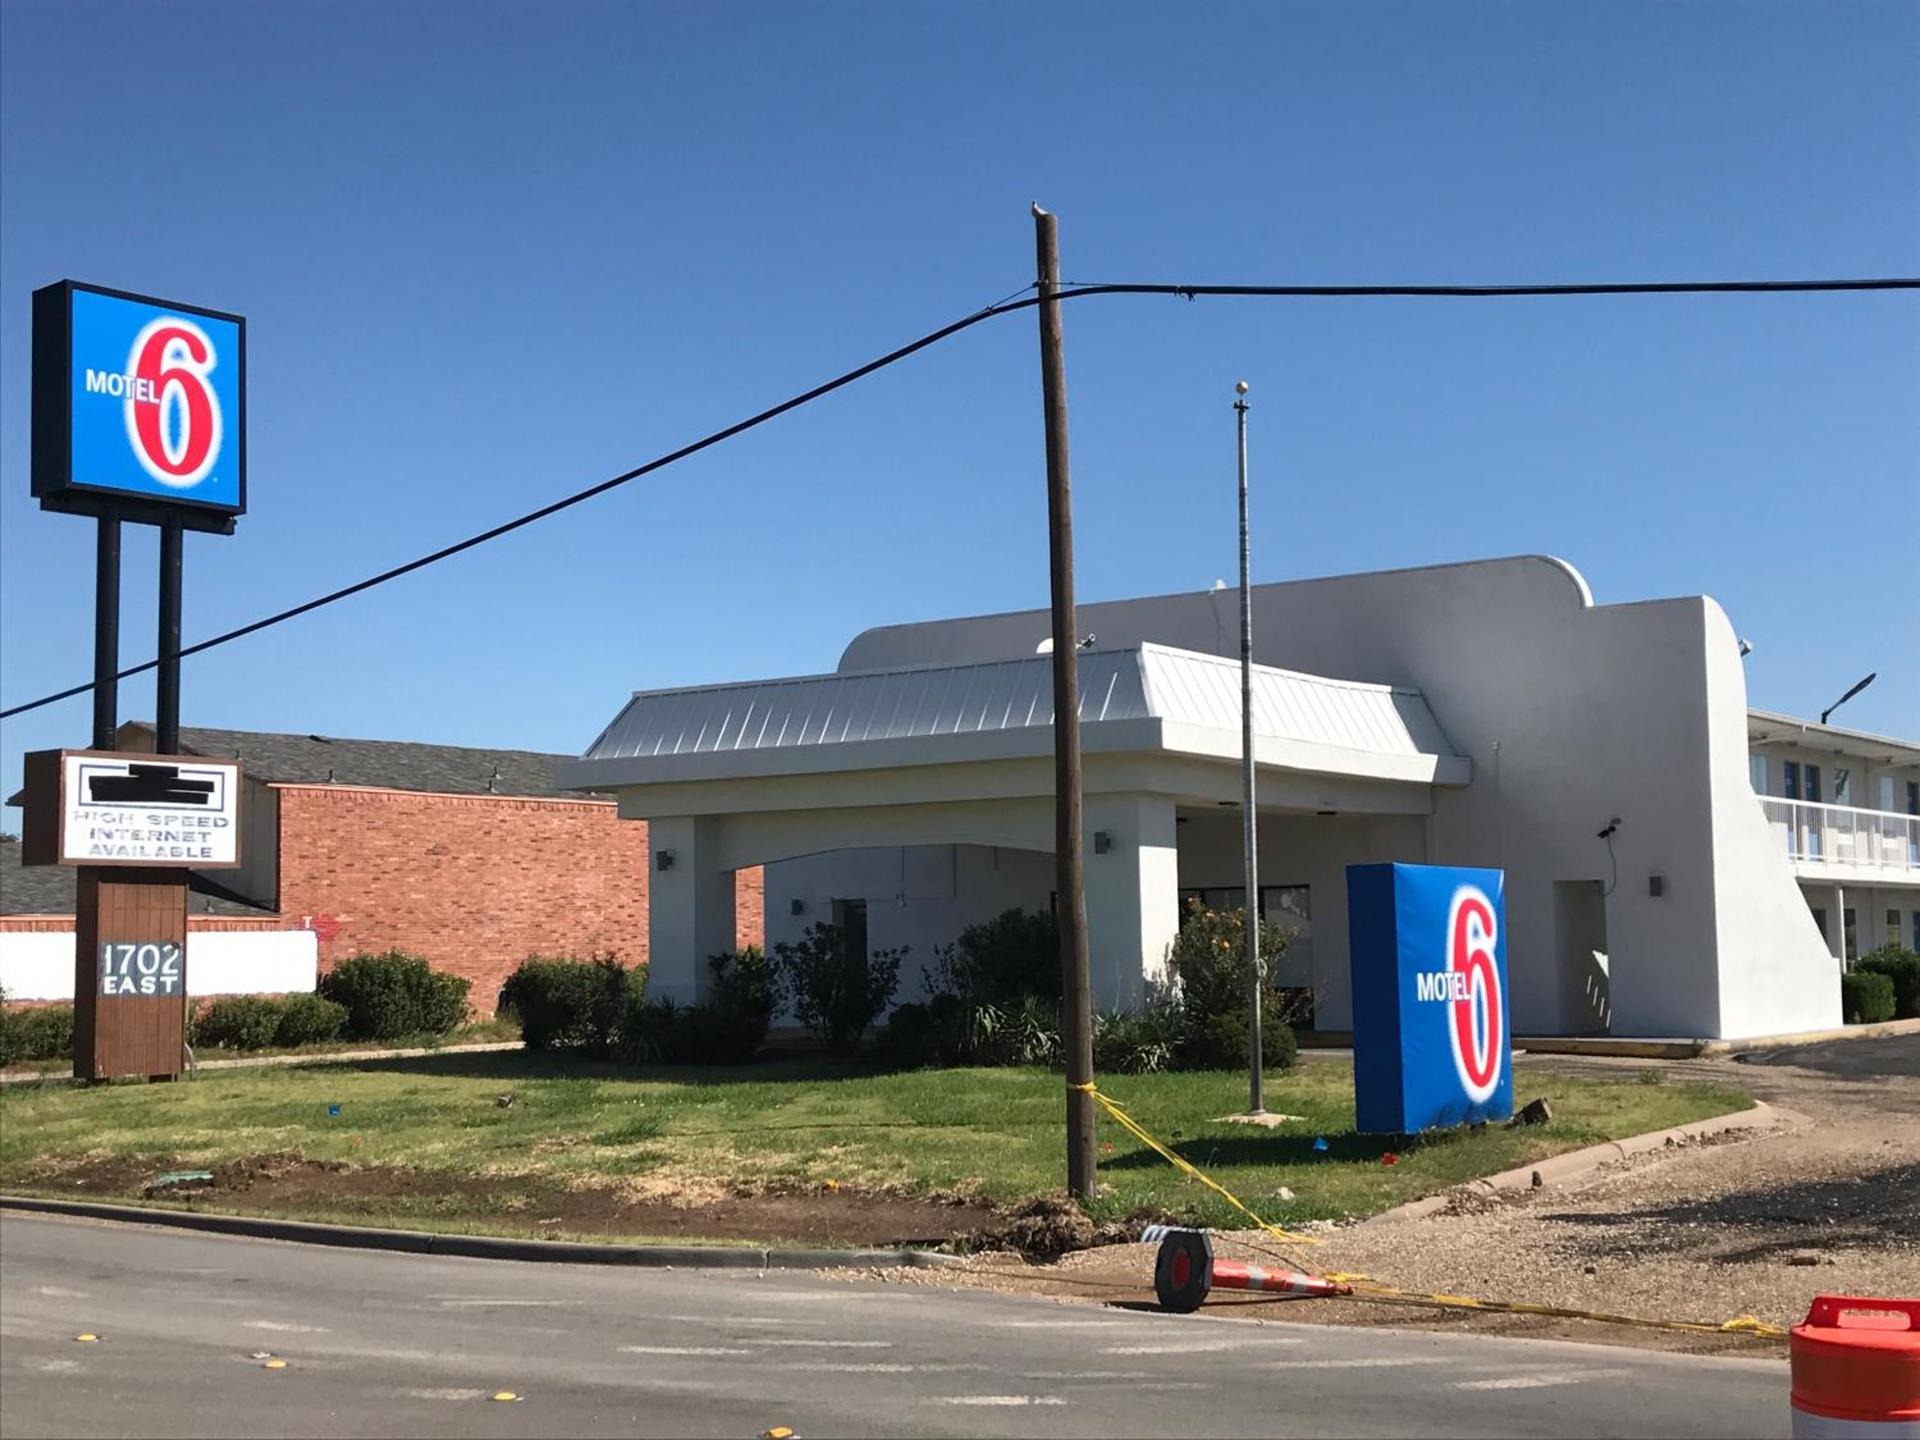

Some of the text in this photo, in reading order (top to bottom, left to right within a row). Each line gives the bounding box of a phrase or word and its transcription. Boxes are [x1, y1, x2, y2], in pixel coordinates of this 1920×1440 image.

[85, 320, 219, 483] MOTEL 6
[75, 811, 229, 828] HIGH SPEED
[89, 827, 212, 843] INTERNET
[87, 843, 213, 859] AVAILABLE
[104, 944, 179, 975] 1702
[103, 976, 178, 995] EAST
[1417, 890, 1501, 1097] MOTEL 6
